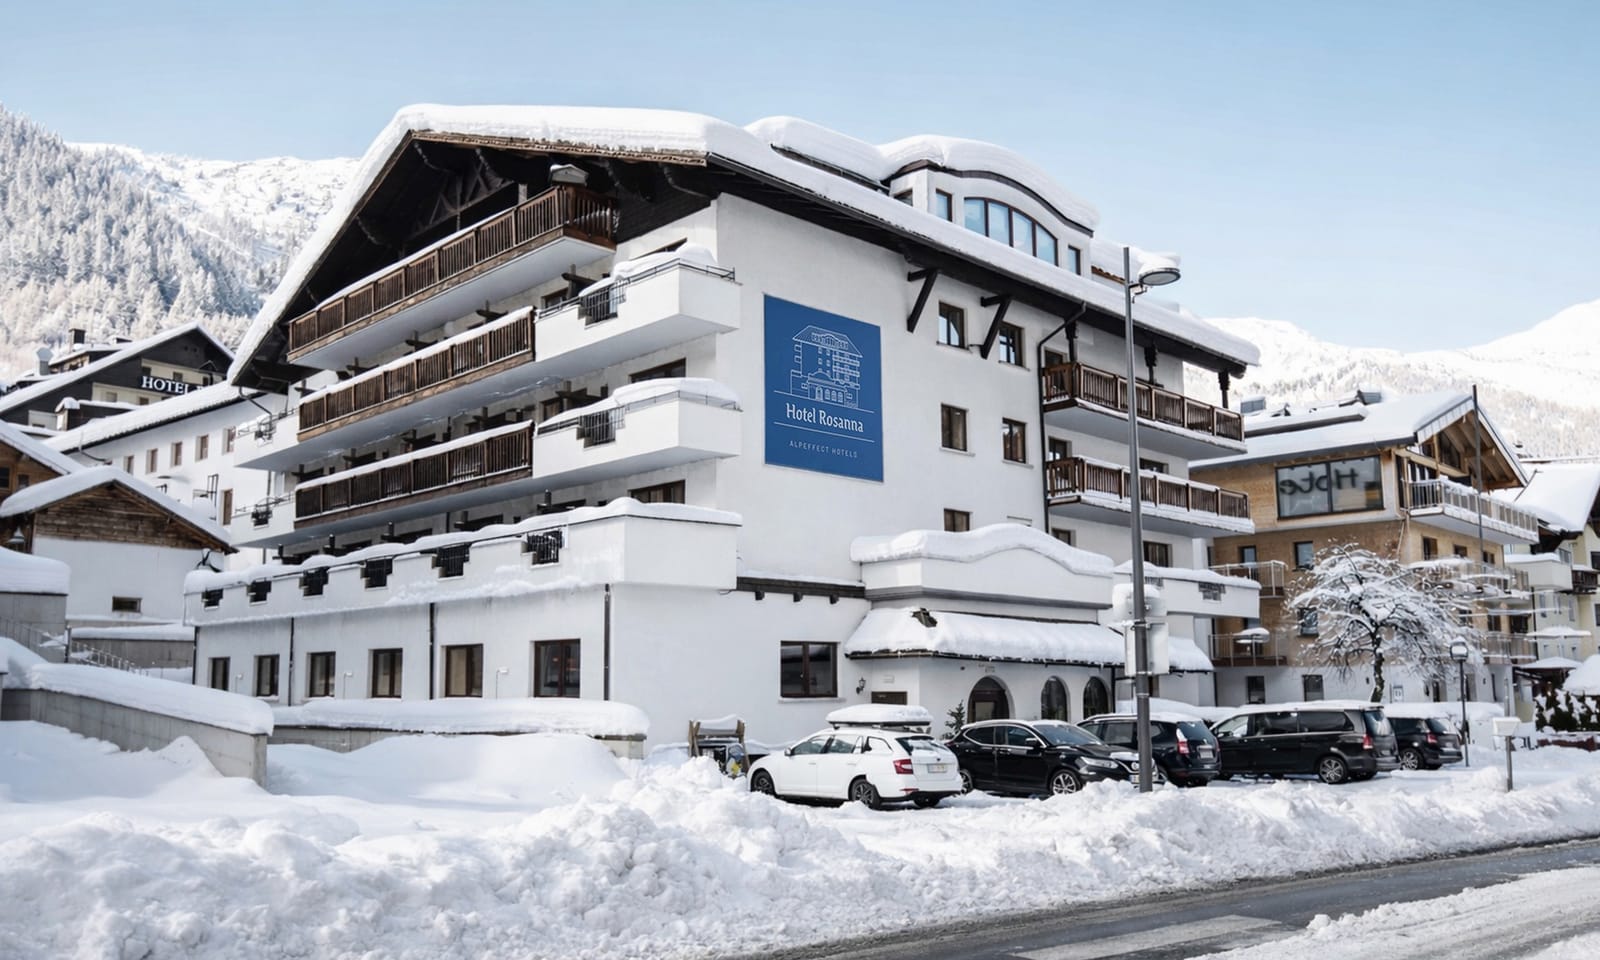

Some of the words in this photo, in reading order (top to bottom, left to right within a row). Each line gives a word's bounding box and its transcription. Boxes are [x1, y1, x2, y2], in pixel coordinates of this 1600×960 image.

[786, 402, 816, 424] Hotel
[819, 409, 864, 433] Rosanna
[789, 440, 829, 454] ALPEFFECT
[831, 447, 858, 459] HOTELS
